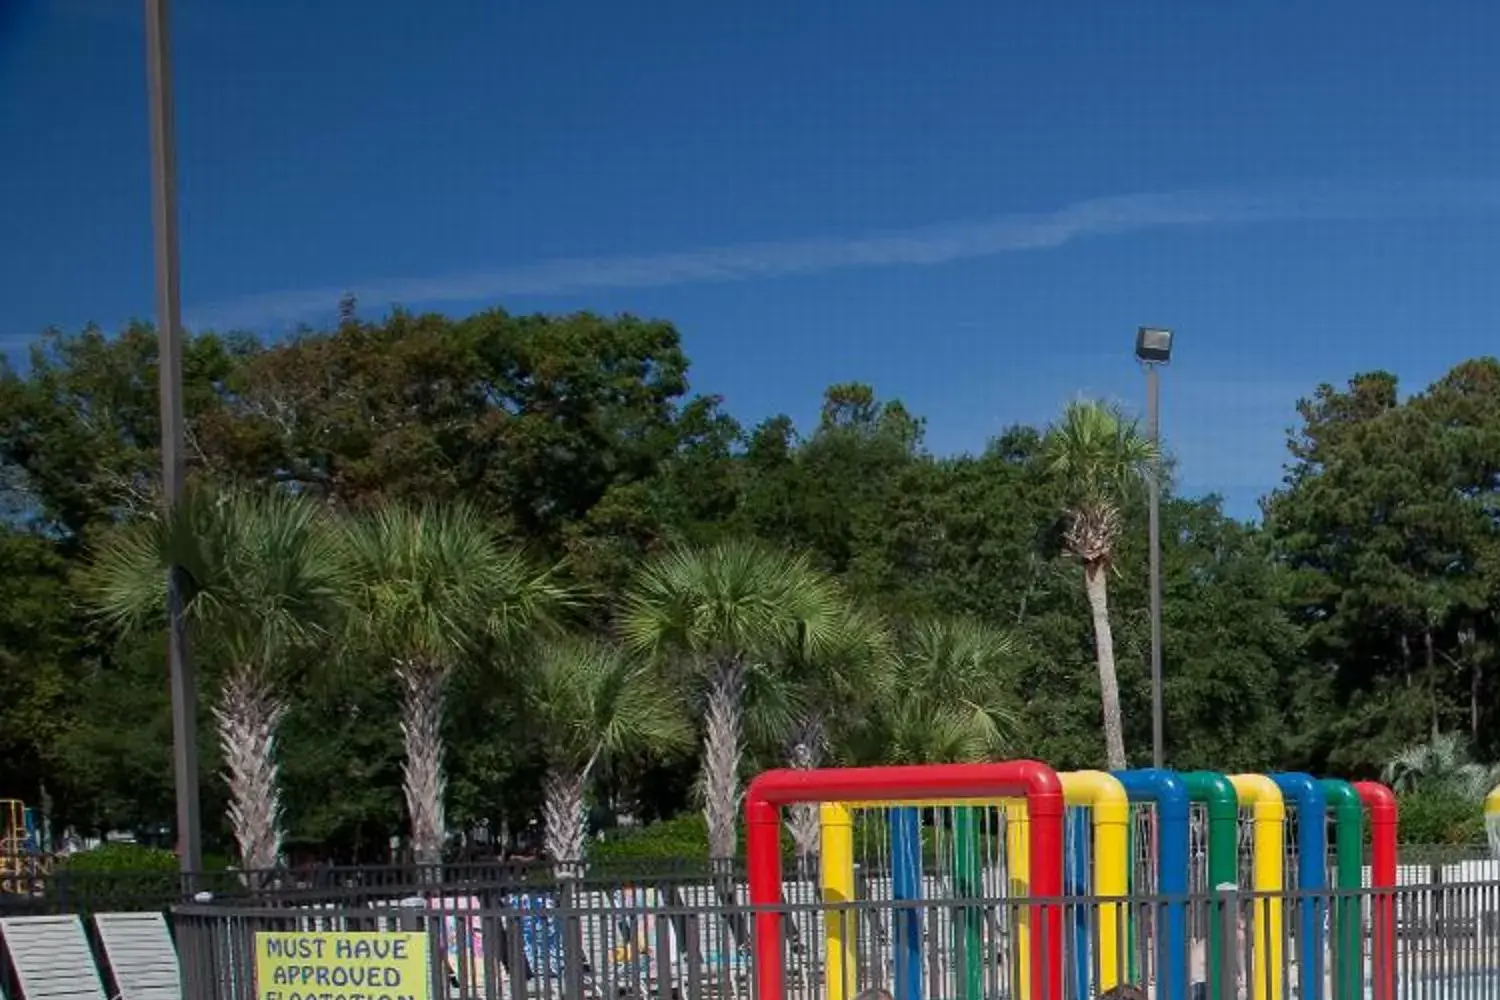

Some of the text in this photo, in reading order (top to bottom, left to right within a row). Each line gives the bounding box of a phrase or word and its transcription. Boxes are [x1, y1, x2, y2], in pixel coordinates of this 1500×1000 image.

[266, 938, 409, 960] MUST HAVE
[273, 966, 401, 987] APPROVED
